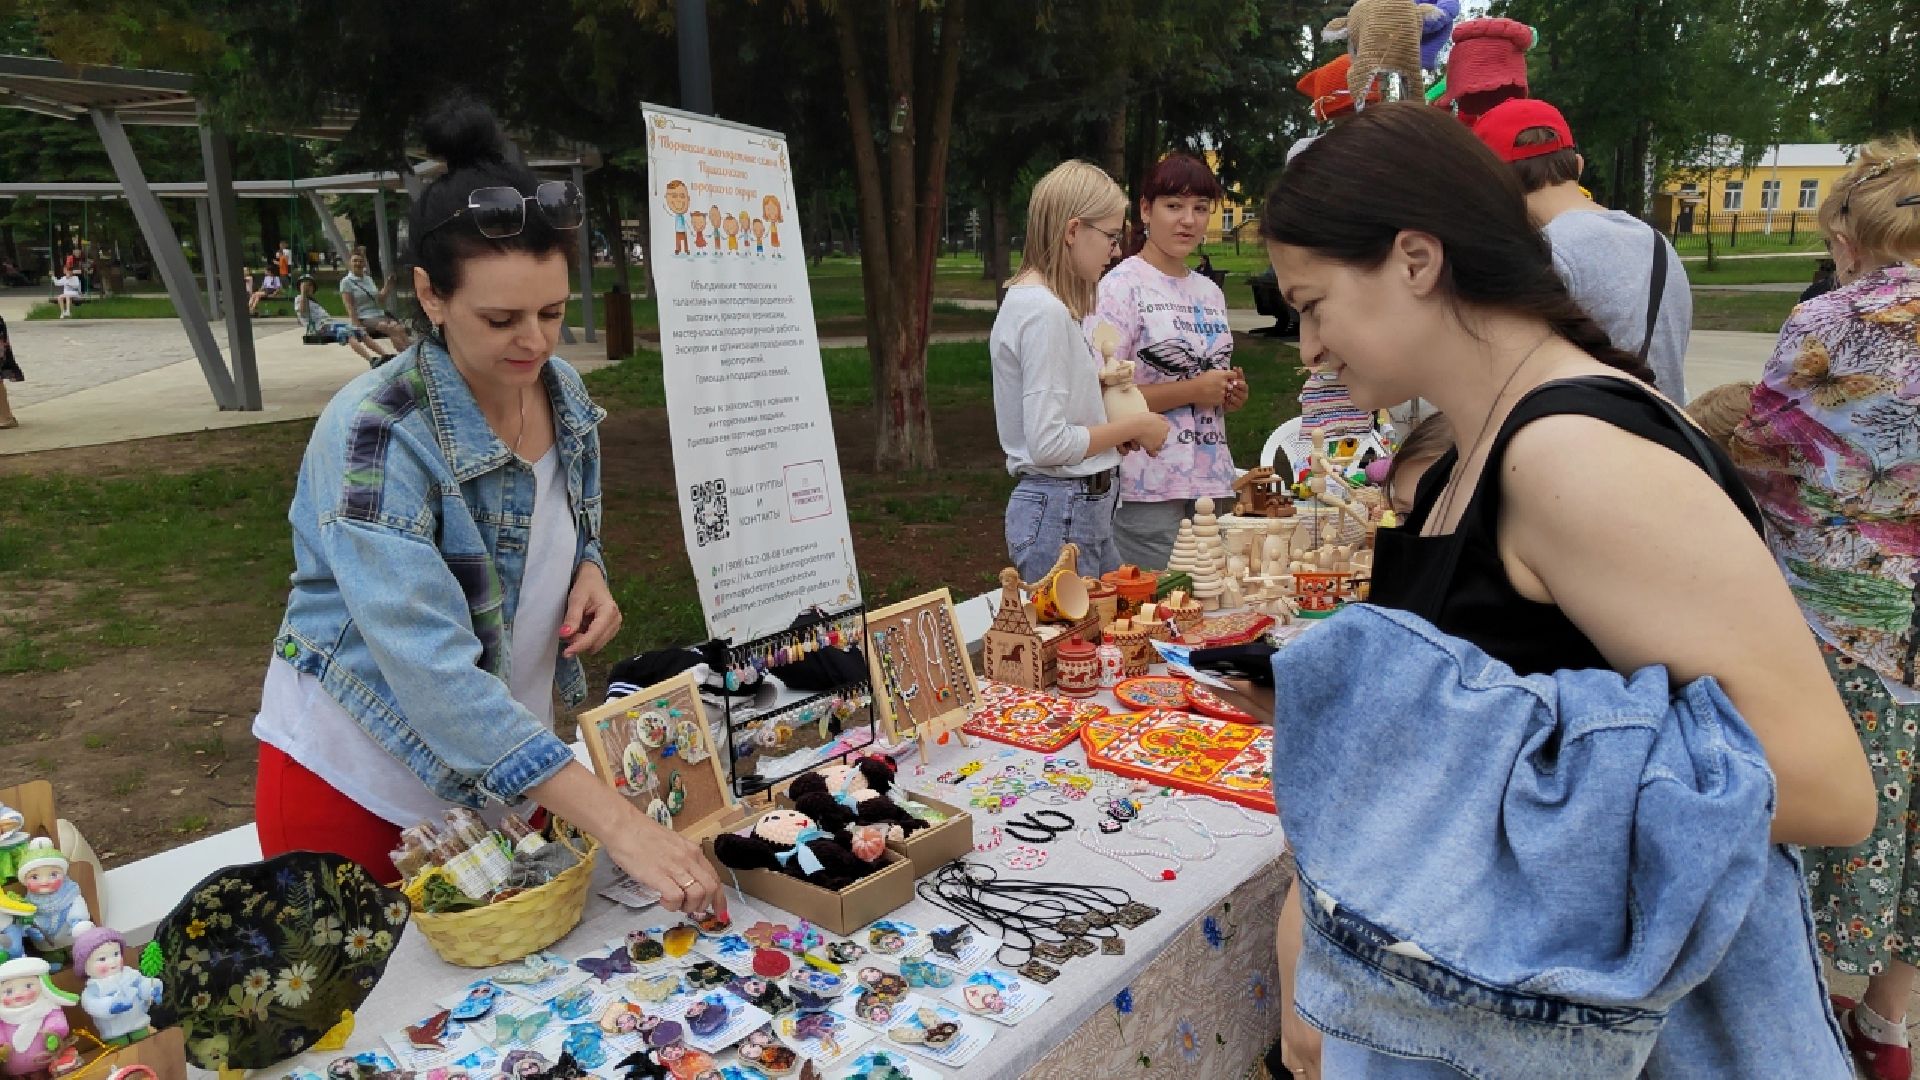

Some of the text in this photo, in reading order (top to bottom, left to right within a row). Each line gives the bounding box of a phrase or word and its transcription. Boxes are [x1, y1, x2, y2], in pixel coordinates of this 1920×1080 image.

[755, 479, 784, 492] ГРУППЫ
[756, 498, 764, 507] И
[739, 510, 781, 526] КОНТАКТЫ
